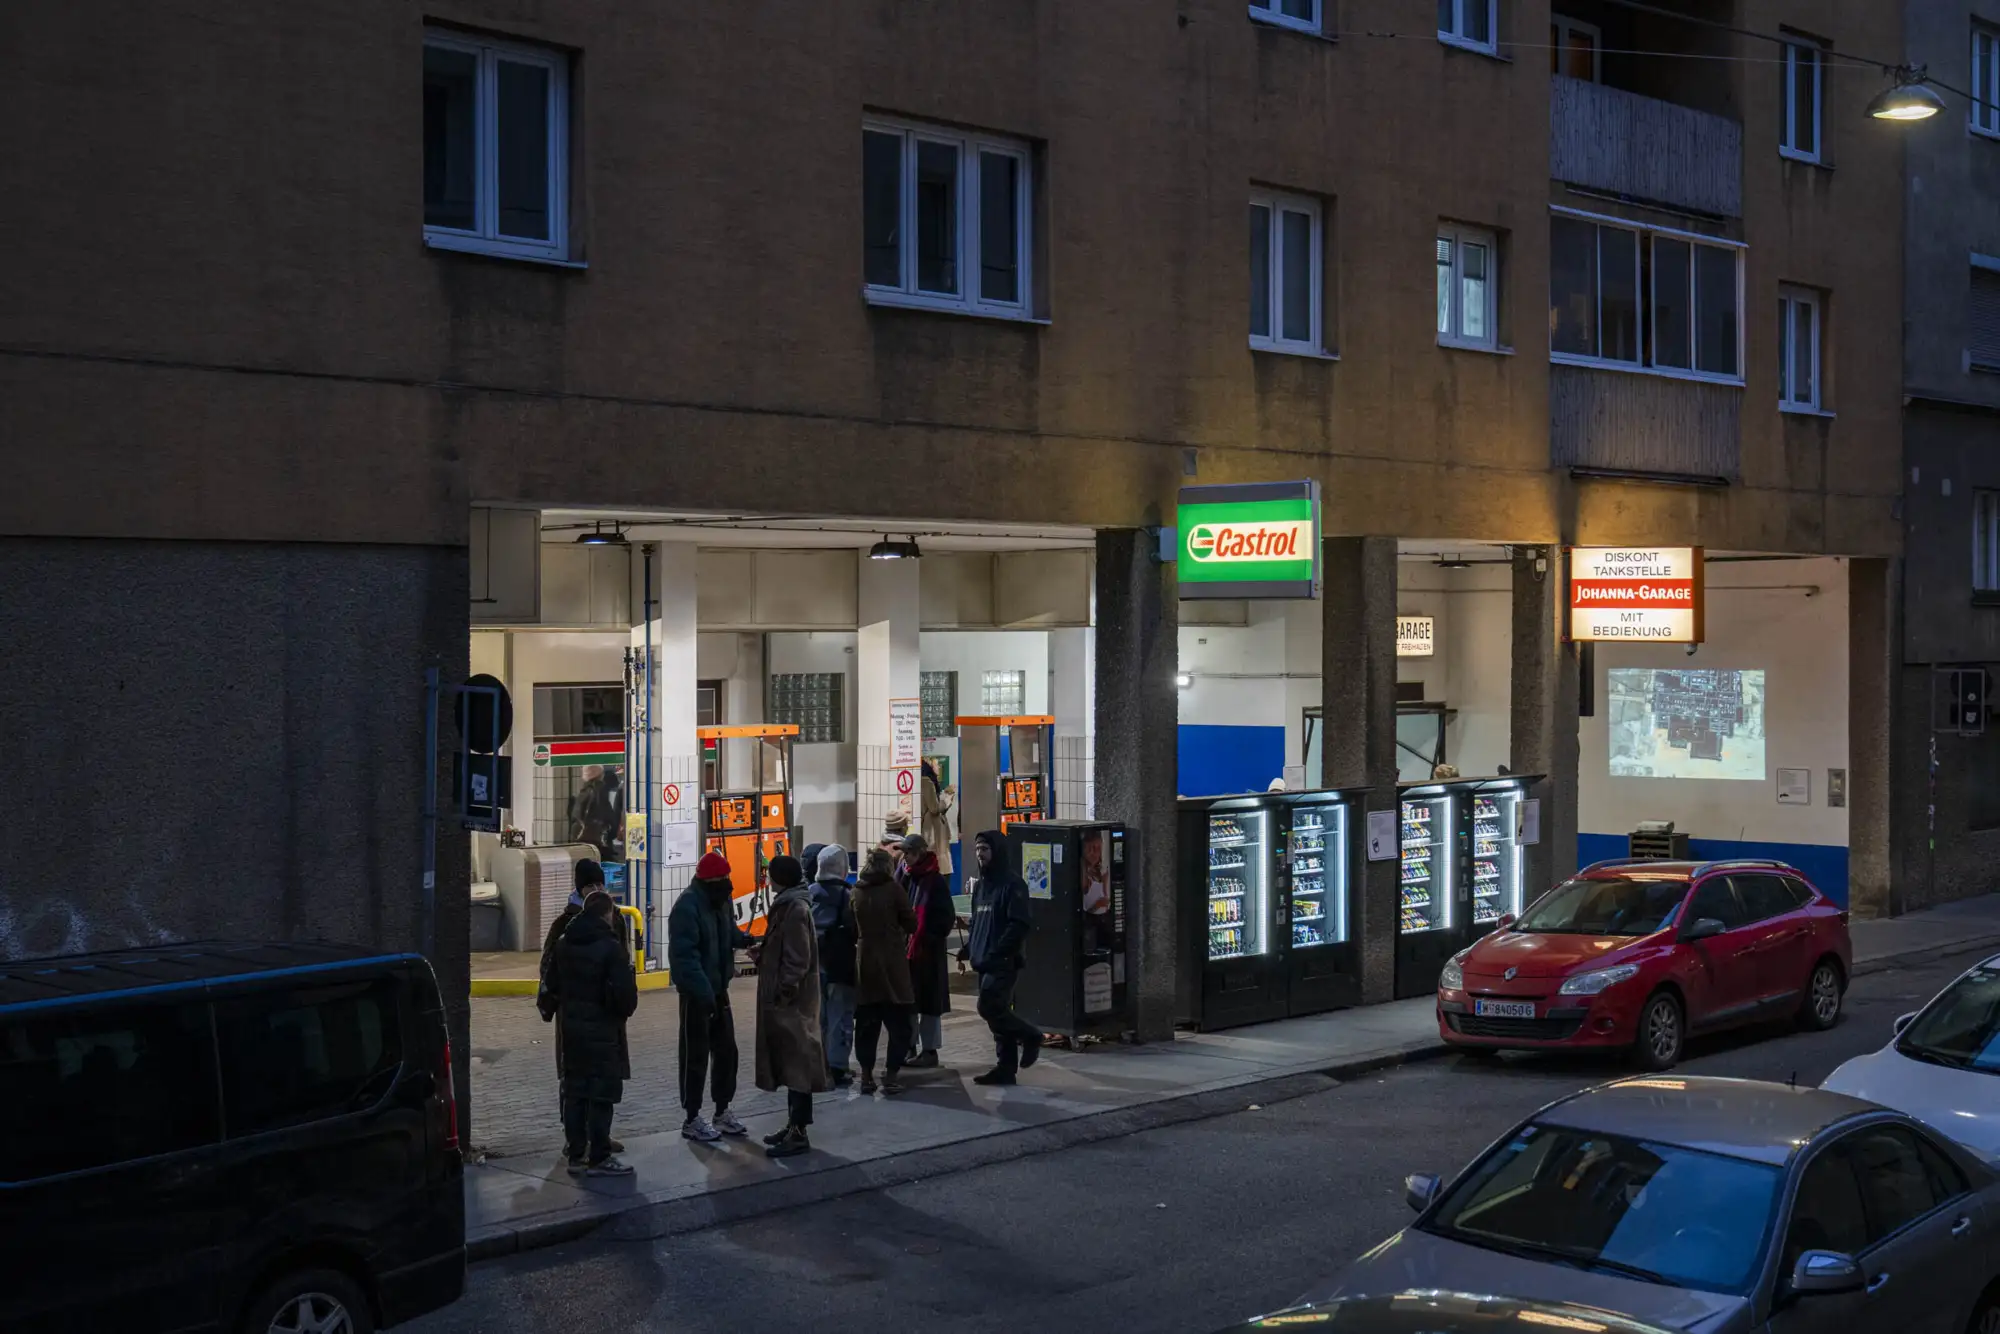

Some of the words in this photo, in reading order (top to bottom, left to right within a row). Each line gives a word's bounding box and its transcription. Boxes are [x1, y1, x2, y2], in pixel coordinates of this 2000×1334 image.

[1215, 527, 1298, 557] Castrol
[1605, 552, 1659, 562] DISKONT
[1593, 566, 1671, 576] TANKSTELLE
[1575, 585, 1691, 603] JOHANNA-GARAGE
[1620, 613, 1643, 622] MIT
[1593, 626, 1671, 636] BEDIENUNG
